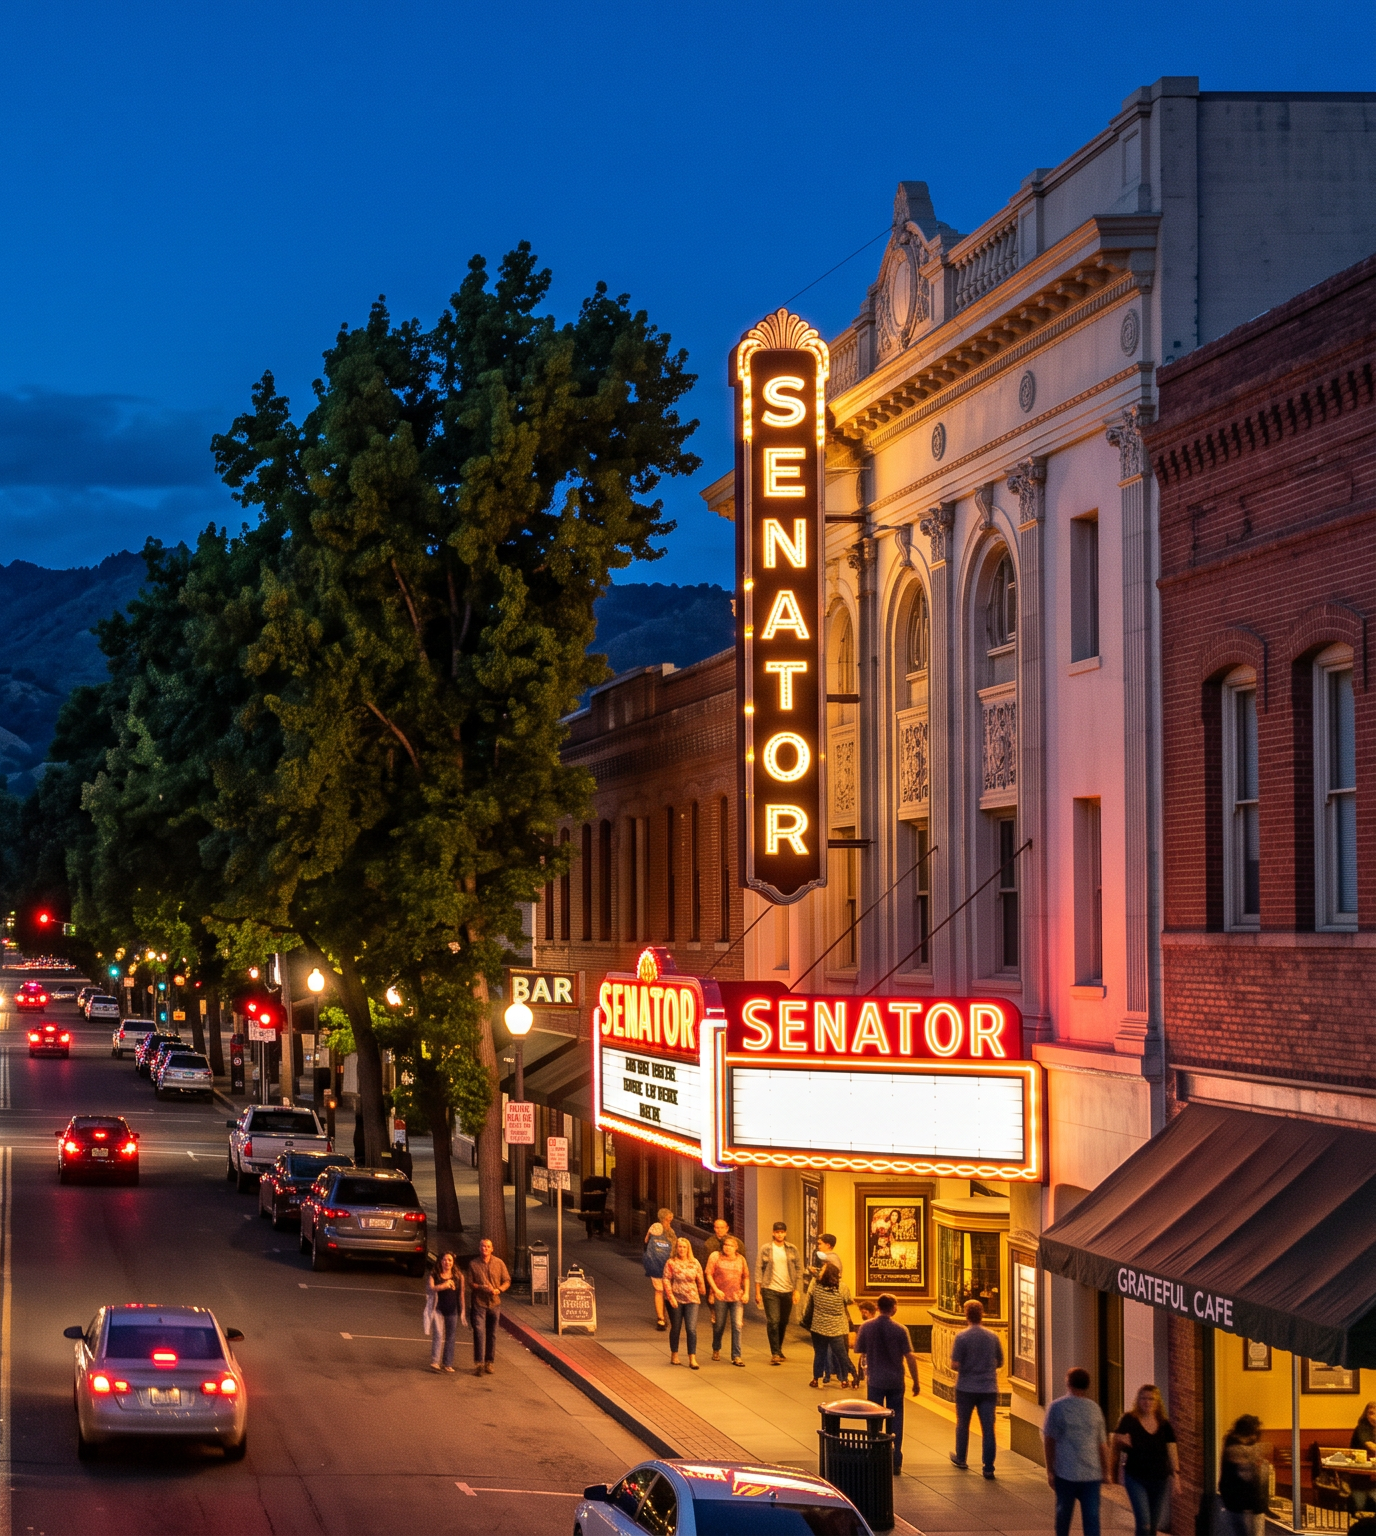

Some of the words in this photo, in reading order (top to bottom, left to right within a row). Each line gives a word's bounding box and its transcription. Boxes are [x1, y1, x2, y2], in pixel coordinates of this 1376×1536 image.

[760, 374, 810, 856] SENATOR
[512, 976, 572, 1003] BAR
[599, 981, 696, 1049] SENATOR
[741, 998, 1006, 1058] SENATOR
[1117, 1267, 1188, 1313] GRATEFUL
[1193, 1290, 1234, 1327] CAFE
